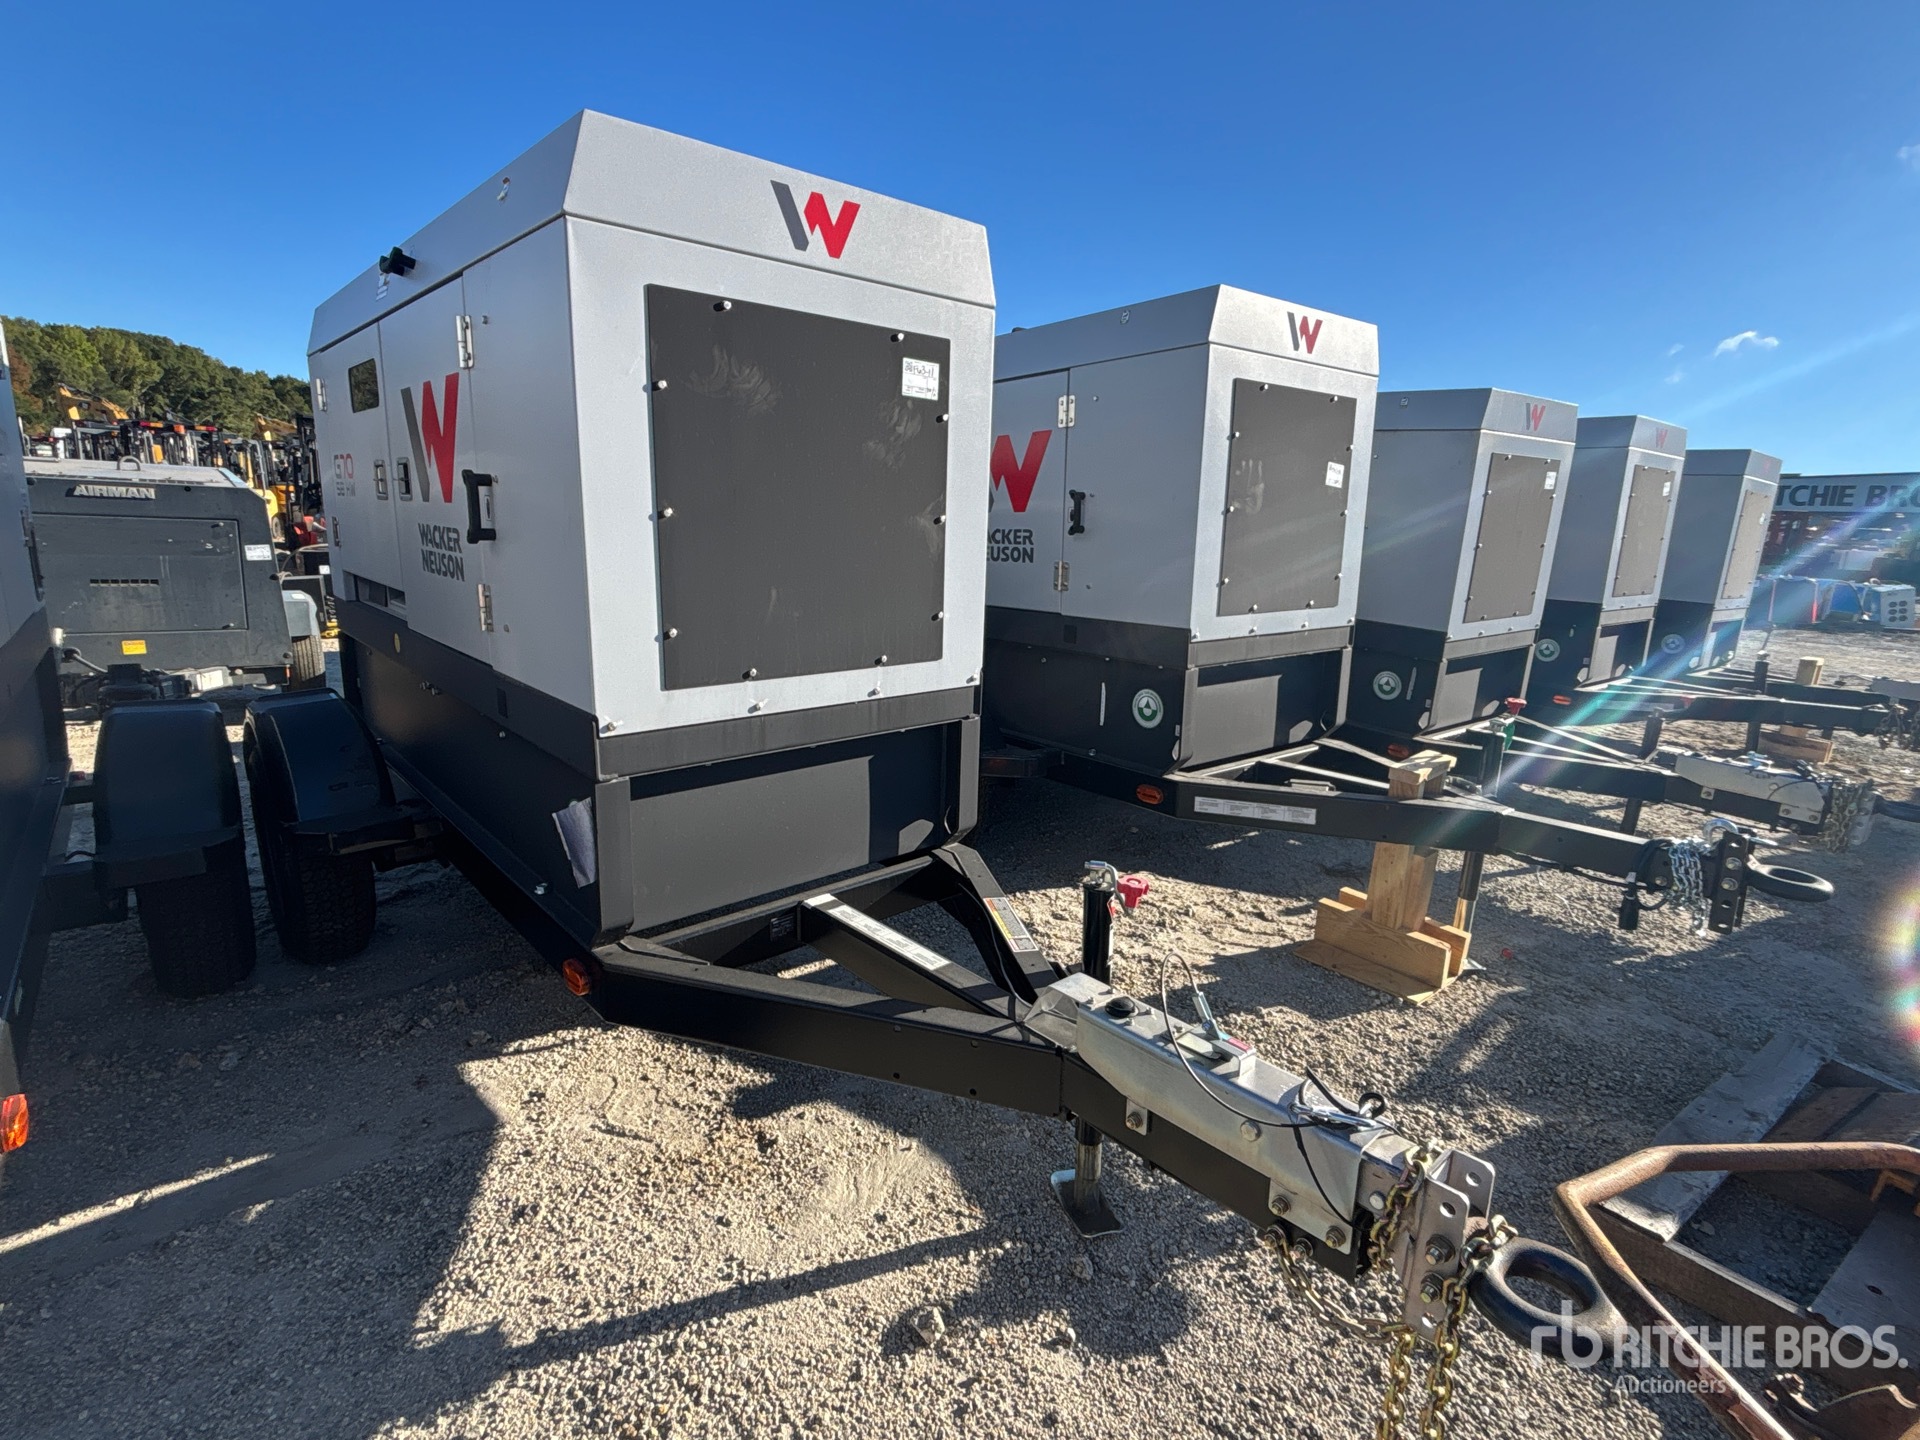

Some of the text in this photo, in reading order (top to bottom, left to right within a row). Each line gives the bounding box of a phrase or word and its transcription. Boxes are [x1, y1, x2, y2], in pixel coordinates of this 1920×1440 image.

[334, 453, 354, 479] G70
[73, 484, 156, 499] AIRMAN
[1776, 485, 1857, 507] TCHIE
[418, 523, 462, 553] WACKER
[987, 528, 1034, 545] CKER
[421, 549, 465, 582] NEUSON
[987, 546, 1034, 563] USON
